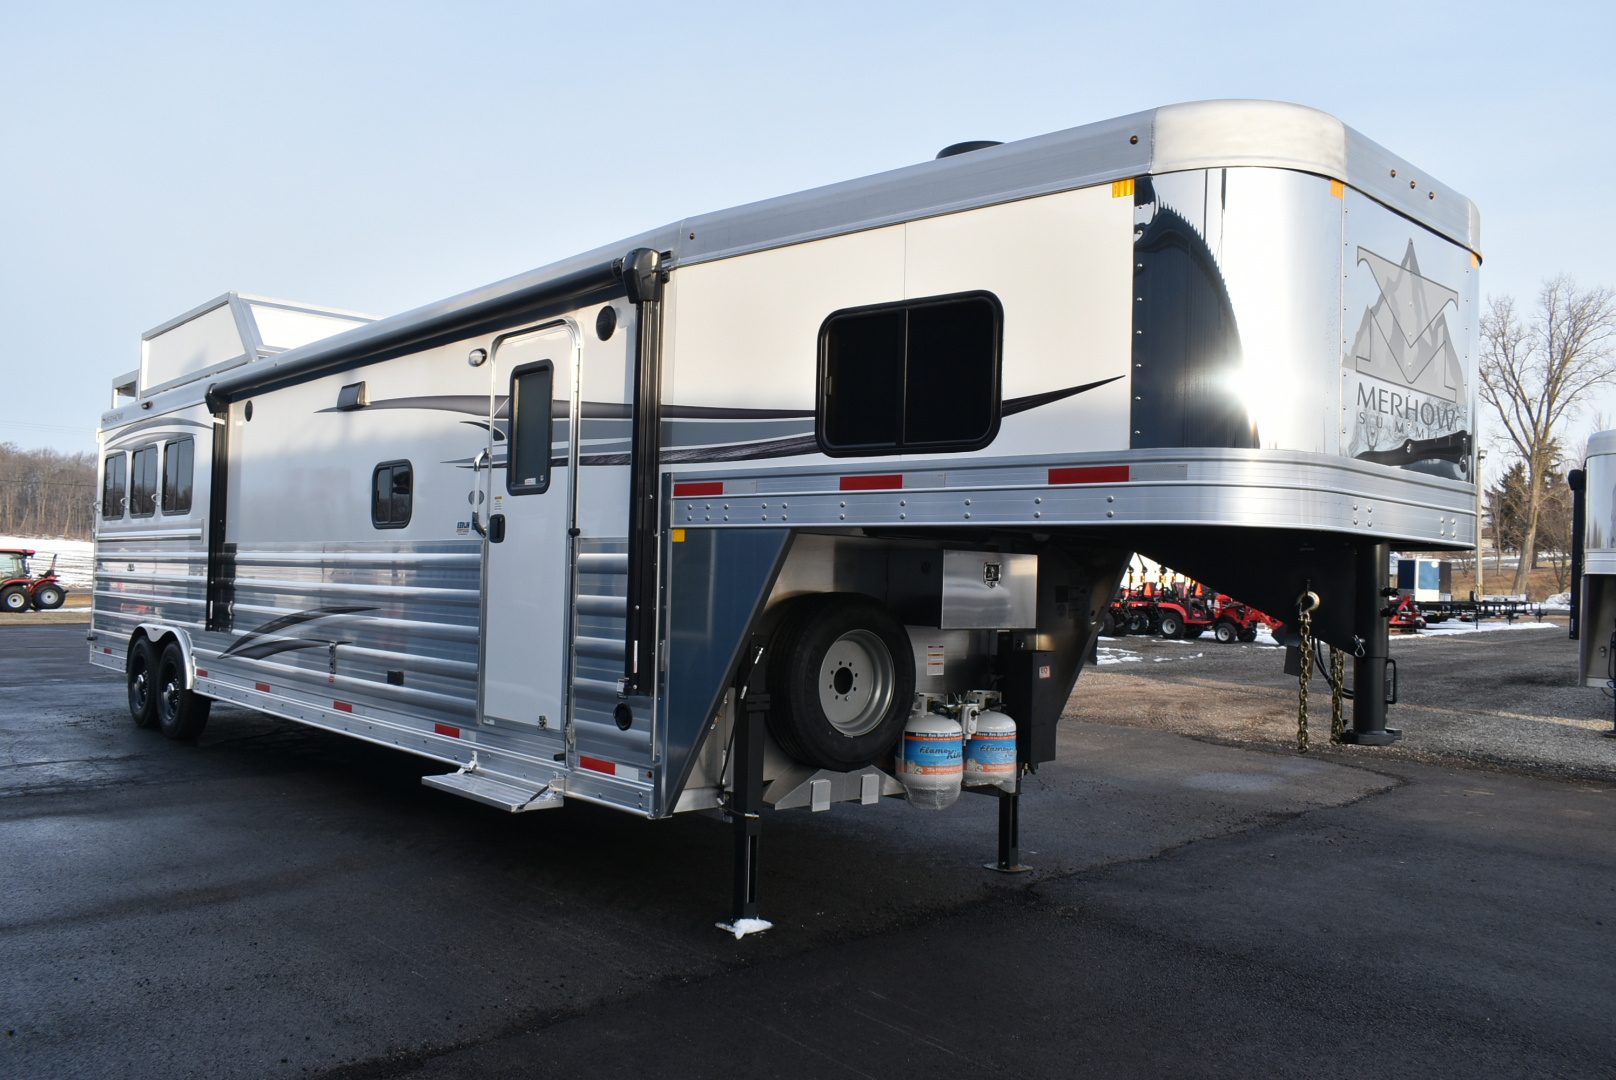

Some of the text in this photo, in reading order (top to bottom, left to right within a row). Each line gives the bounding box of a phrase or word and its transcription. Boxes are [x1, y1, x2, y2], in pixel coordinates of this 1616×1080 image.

[1357, 382, 1456, 431] MERHOW
[1359, 412, 1454, 447] SUMMIT
[919, 745, 949, 754] Flame
